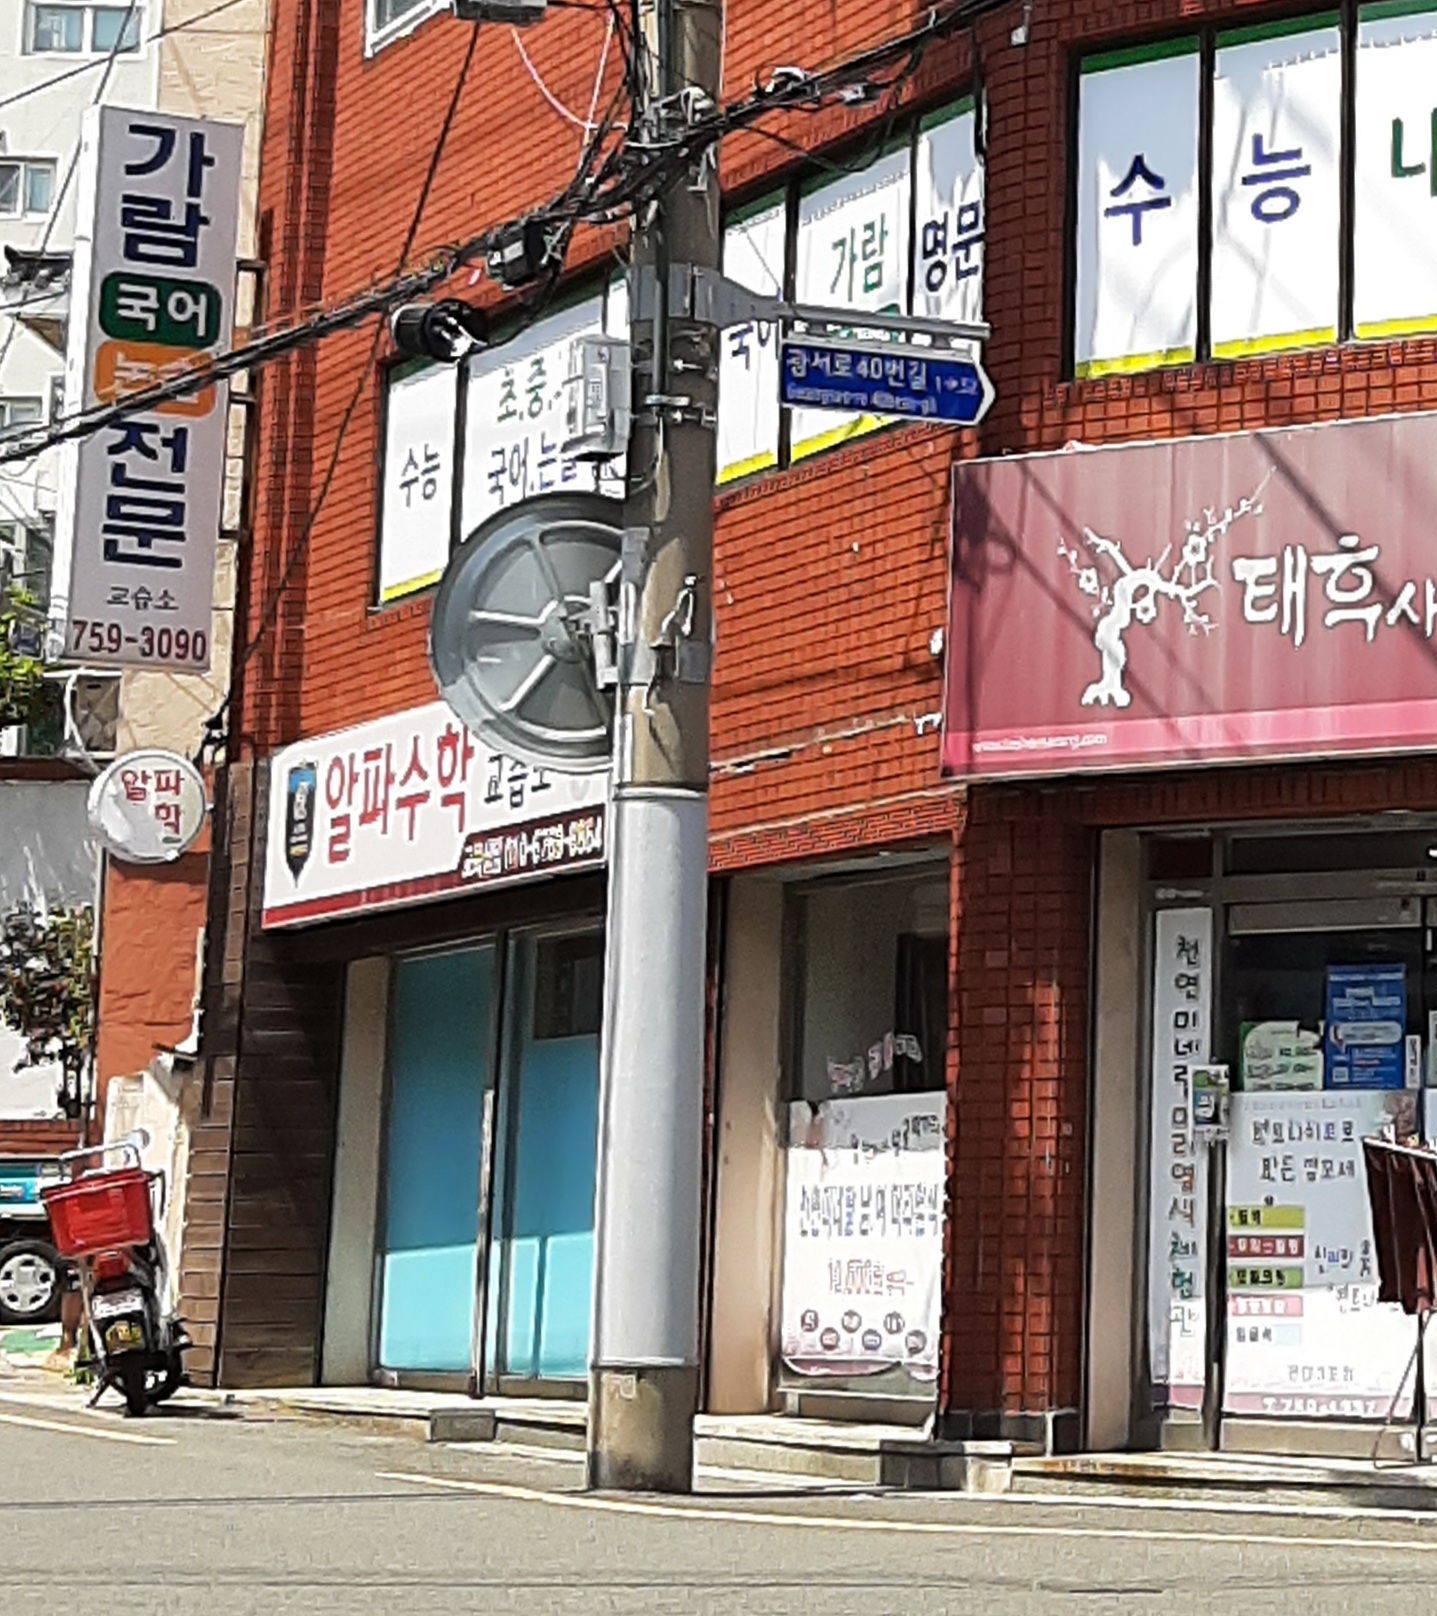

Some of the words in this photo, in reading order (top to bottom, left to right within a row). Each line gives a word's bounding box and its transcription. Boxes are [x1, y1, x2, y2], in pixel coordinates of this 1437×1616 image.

[119, 123, 215, 269] 가람
[1103, 132, 1311, 247] 수능
[831, 212, 889, 302] 가람
[921, 199, 986, 293] 명문
[117, 283, 208, 337] 국어
[102, 420, 187, 569] 전문
[71, 619, 208, 662] 759-3090
[106, 585, 179, 612] 교습소
[121, 769, 185, 802] 알파
[325, 722, 475, 864] 알파수학
